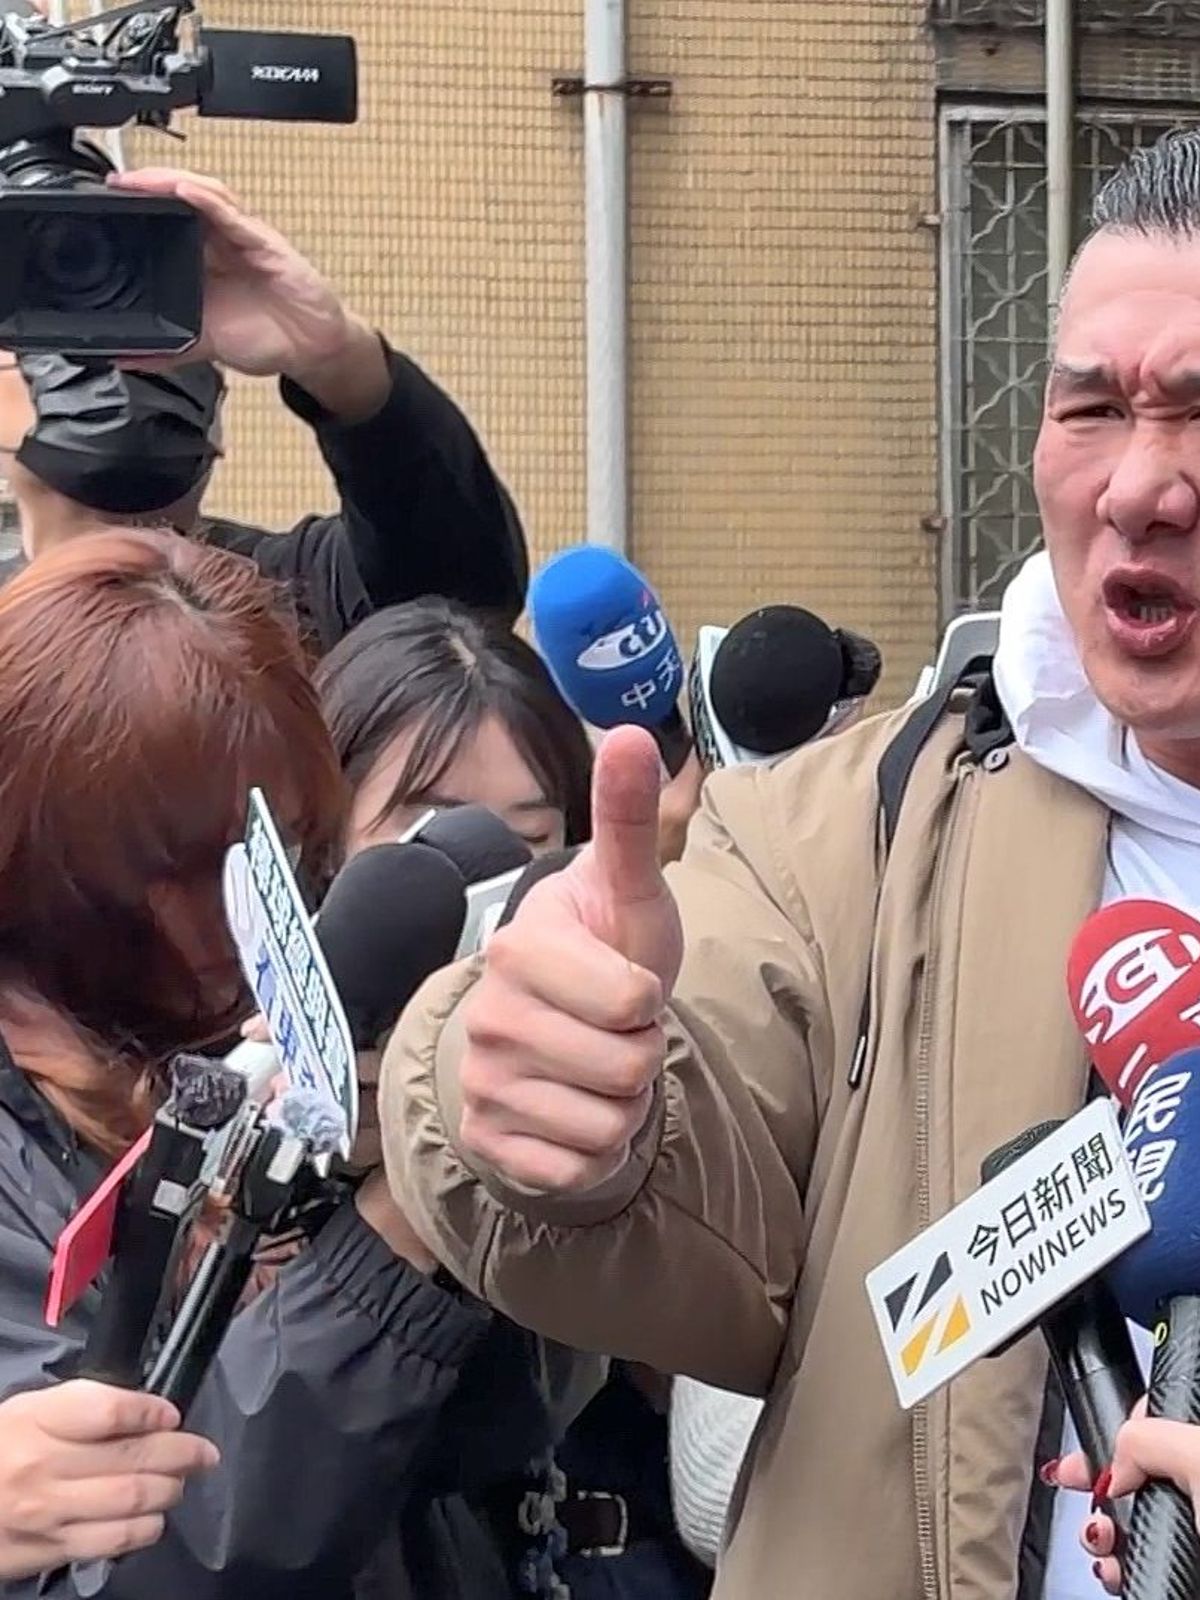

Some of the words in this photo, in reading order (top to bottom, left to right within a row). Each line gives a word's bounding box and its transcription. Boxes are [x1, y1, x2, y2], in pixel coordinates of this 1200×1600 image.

[621, 648, 680, 709] 中天
[967, 1132, 1114, 1267] 今日新聞
[980, 1188, 1127, 1316] NOWNEWS
